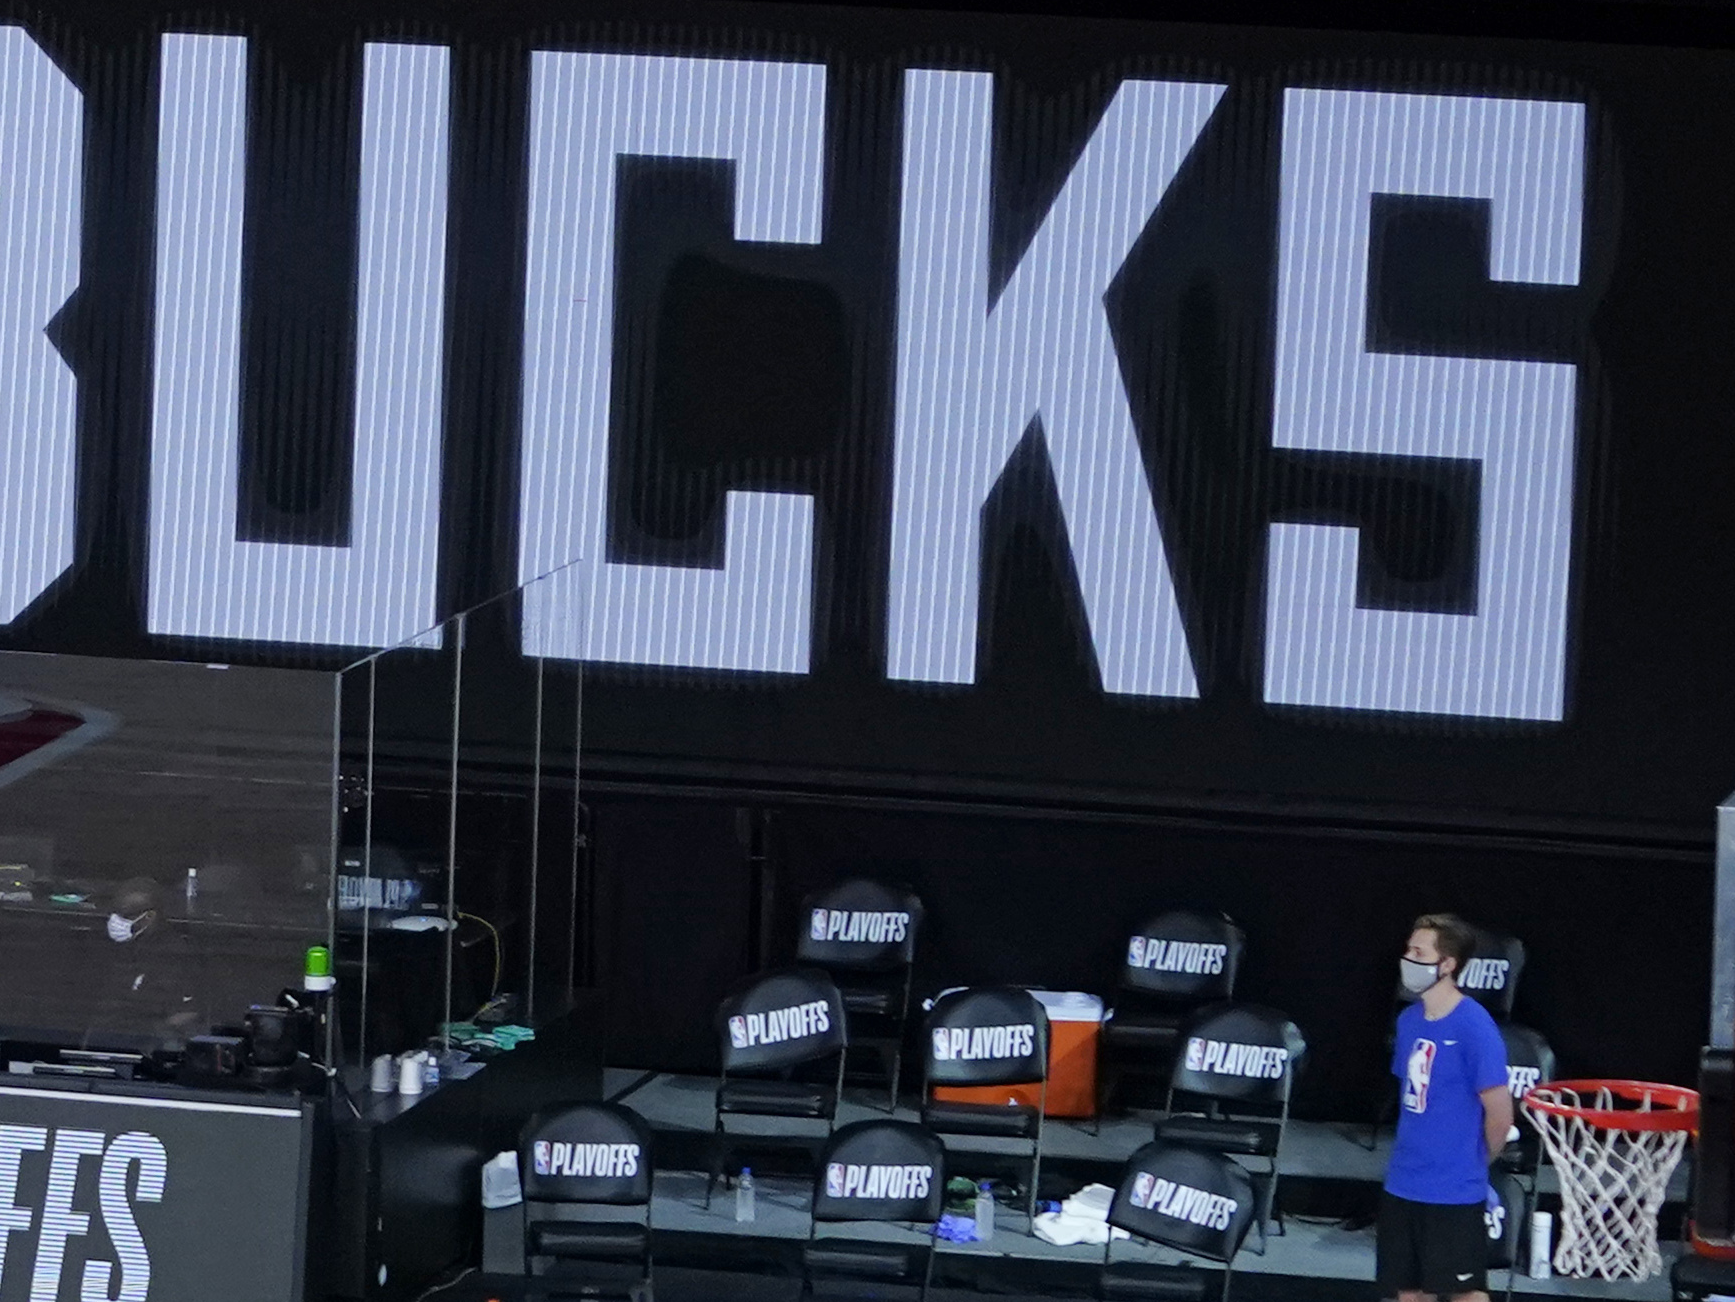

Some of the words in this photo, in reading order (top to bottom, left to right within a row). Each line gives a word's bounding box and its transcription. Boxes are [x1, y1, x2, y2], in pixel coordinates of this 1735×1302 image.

[827, 910, 909, 943] PLAYOFFS
[1144, 938, 1227, 975] PLAYOFFS
[747, 1000, 829, 1046] PLAYOFFS
[951, 1024, 1035, 1060] PLAYOFFS
[1202, 1040, 1288, 1079] PLAYOFFS
[550, 1142, 641, 1178] PLAYOFFS
[844, 1165, 933, 1200] PLAYOFFS
[1146, 1178, 1238, 1231] PLAYOFFS
